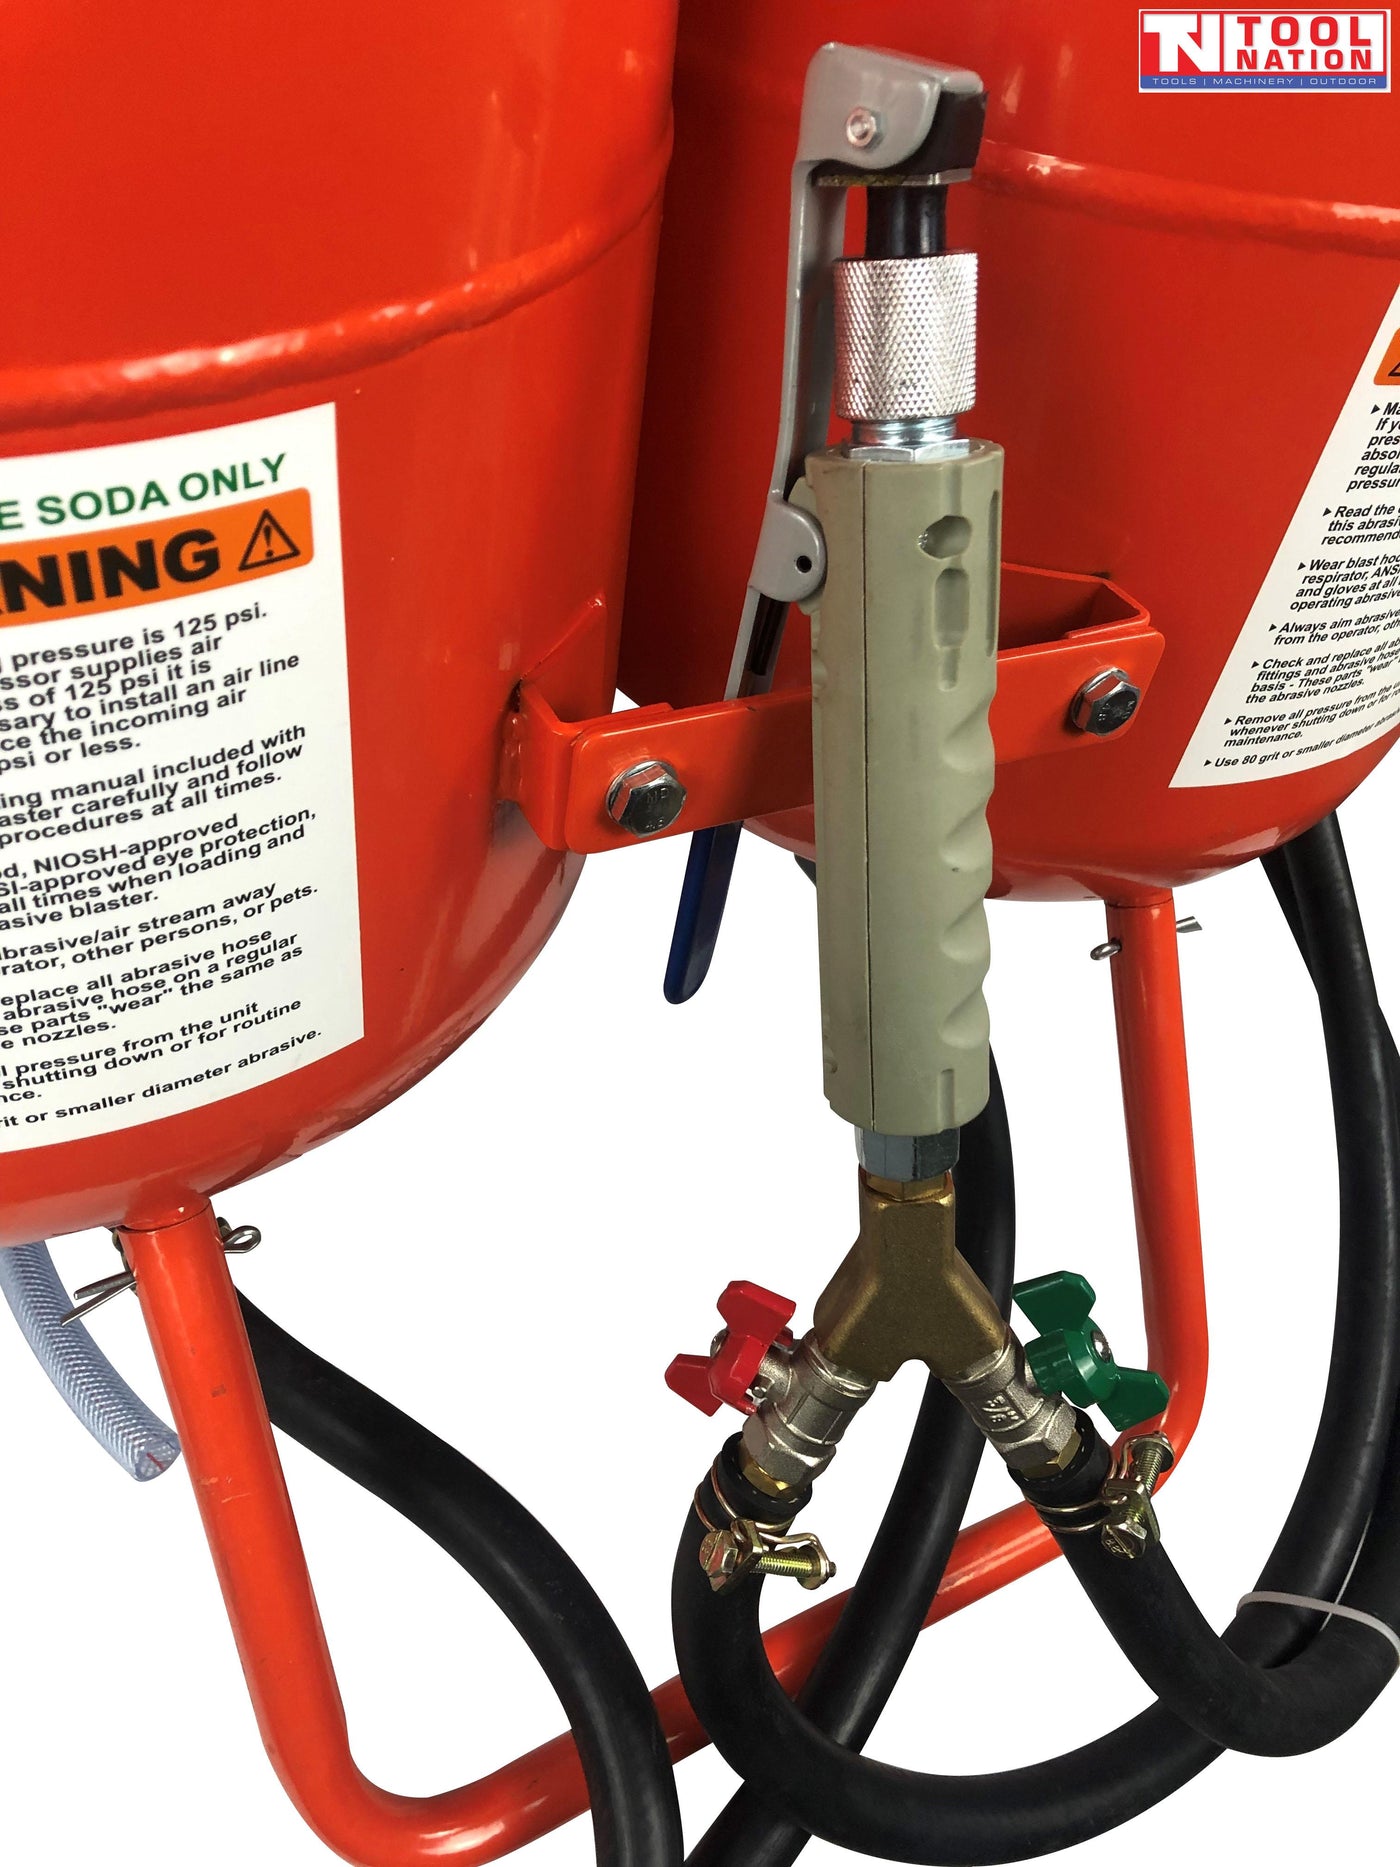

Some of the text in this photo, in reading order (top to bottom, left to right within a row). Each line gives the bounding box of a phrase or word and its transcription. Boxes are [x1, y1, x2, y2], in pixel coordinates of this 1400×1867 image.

[1375, 417, 1390, 431] If
[37, 481, 169, 525] SODA
[179, 453, 286, 502] ONLY
[1328, 519, 1355, 532] this
[1334, 504, 1395, 518] Read the
[1321, 530, 1400, 545] recommend
[0, 528, 220, 614] NING
[1302, 570, 1369, 585] respirator,
[1309, 559, 1345, 571] Wear
[1346, 555, 1379, 569] blast
[1290, 597, 1353, 612] operating
[1296, 576, 1398, 598] and gloves at all
[11, 602, 267, 672] pressure is 125 psi.
[1274, 624, 1380, 645] from the operator,
[1279, 621, 1327, 634] Always
[1330, 618, 1352, 629] aim
[70, 647, 183, 680] supplies
[191, 635, 222, 655] air
[1256, 670, 1301, 681] fittings
[1304, 665, 1330, 677] and
[1329, 656, 1375, 673] abrasive
[1262, 639, 1387, 669] Check and replace all
[29, 659, 211, 707] of 125 psi it is
[64, 706, 91, 721] to
[100, 684, 177, 715] install
[186, 679, 215, 696] an
[223, 667, 253, 687] air
[260, 655, 299, 677] line
[1246, 679, 1364, 704] the abrasive nozzles.
[1251, 681, 1285, 692] basis
[1298, 676, 1333, 688] These
[1334, 669, 1362, 684] parts
[0, 689, 246, 751] ce the incoming air
[1230, 723, 1290, 736] whenever
[1292, 712, 1337, 730] shutting
[1339, 703, 1365, 719] down
[1235, 699, 1352, 725] Remove all pressure
[45, 748, 72, 763] or
[80, 737, 141, 758] less.
[1215, 737, 1335, 767] Use 80 grit or smaller
[1224, 730, 1303, 747] maintenance.
[51, 768, 144, 800] manual
[153, 740, 254, 780] included
[261, 725, 305, 750] with
[0, 745, 302, 827] aster carefully and follow
[0, 772, 281, 848] procedures at all times.
[34, 813, 238, 874] NIOSH-approved
[153, 847, 194, 866] eye
[200, 809, 316, 857] protection,
[0, 824, 305, 914] all times when loading and
[0, 890, 158, 931] asive blaster.
[0, 883, 276, 961] brasive/air stream away
[72, 941, 134, 963] other
[141, 915, 238, 952] persons,
[243, 903, 265, 918] or
[270, 885, 318, 912] pets.
[1, 930, 272, 1007] eplace all abrasive hose
[3, 934, 298, 1020] abrasive hose on a regular
[31, 1011, 91, 1033] parts
[97, 987, 173, 1014] "wear"
[180, 979, 214, 996] the
[220, 957, 275, 983] same
[280, 947, 303, 962] as
[2, 1000, 301, 1089] shutting down or for routine
[16, 1001, 259, 1077] pressure from the unit
[22, 1021, 117, 1046] nozzles.
[25, 1030, 322, 1124] or smaller diameter abrasive.
